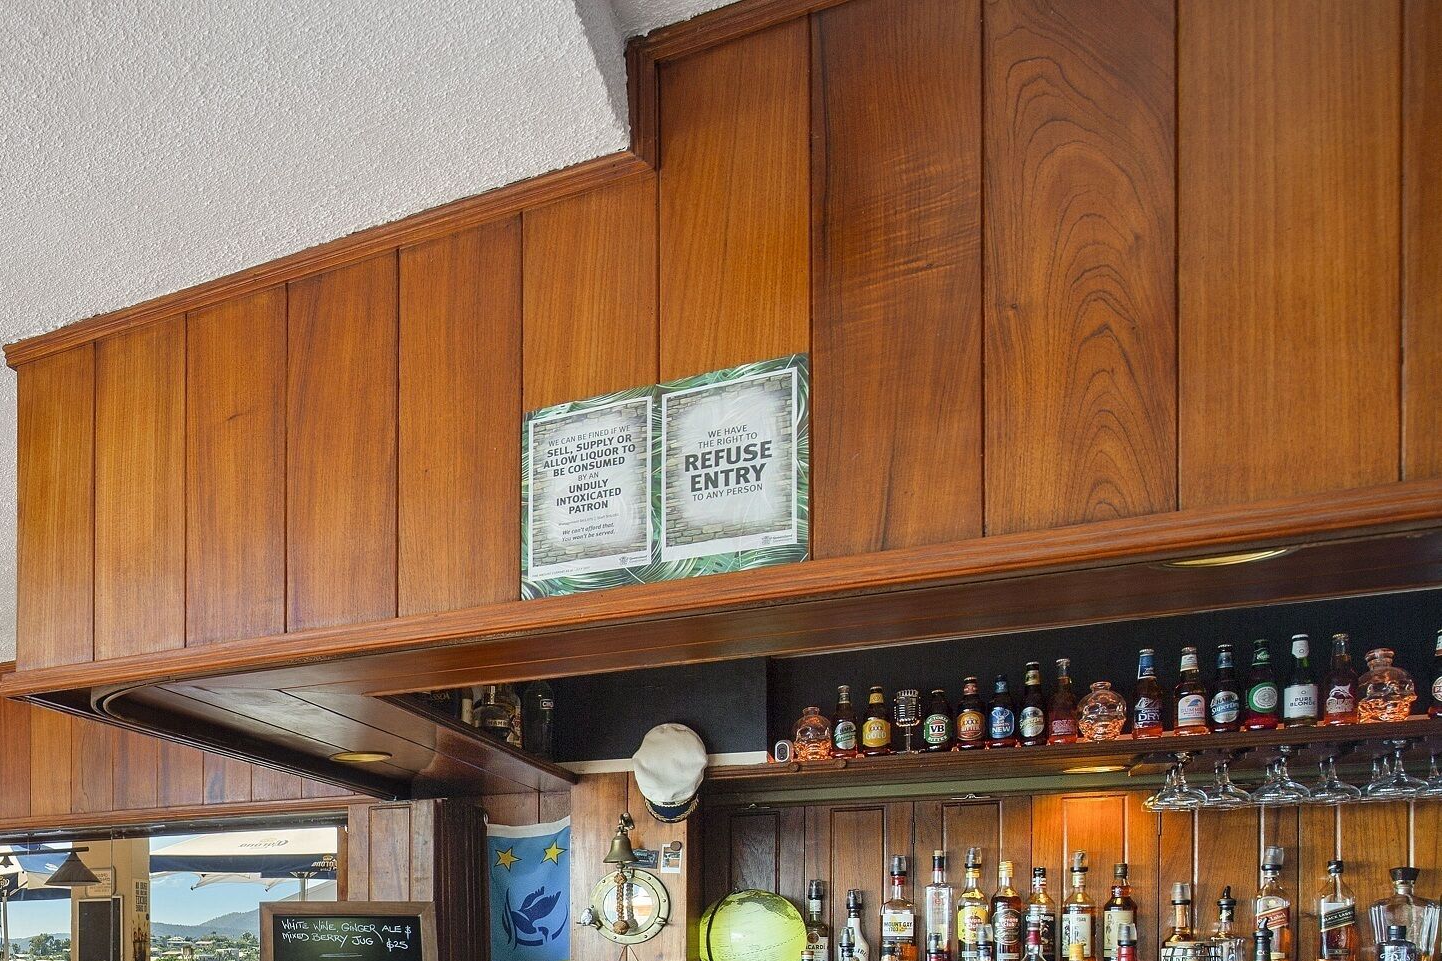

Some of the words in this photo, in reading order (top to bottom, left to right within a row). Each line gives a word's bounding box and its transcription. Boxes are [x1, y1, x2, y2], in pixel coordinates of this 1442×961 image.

[561, 436, 576, 445] CAN
[588, 429, 609, 439] FINED
[619, 425, 631, 433] WE
[708, 429, 722, 438] WE
[724, 425, 748, 435] HAVE
[547, 446, 574, 458] SELL,
[576, 437, 614, 452] SUPPLY
[617, 434, 632, 444] OR
[698, 440, 715, 449] THE
[716, 435, 744, 446] RIGHT
[746, 432, 758, 440] TO
[543, 455, 578, 469] ALLOW
[580, 447, 619, 462] LIQUOR
[622, 444, 636, 454] TO
[684, 440, 773, 473] REFUSE
[553, 468, 566, 477] BE
[567, 456, 625, 474] CONSUMED
[577, 473, 588, 481] BY
[690, 463, 767, 493] ENTRY
[569, 479, 609, 493] UNDULY
[692, 493, 704, 501] TO
[706, 489, 725, 499] ANY
[726, 483, 763, 496] PERSON
[556, 487, 622, 506] INTOXICATED
[568, 500, 608, 514] PATRON
[585, 524, 602, 532] afford
[1138, 713, 1162, 721] DRY
[865, 731, 887, 739] GOLD
[281, 919, 310, 930] WHITE
[381, 925, 402, 933] ALE
[281, 931, 310, 943] MIXED
[311, 932, 349, 948] BERRY
[351, 935, 374, 945] JUG
[386, 938, 409, 952] $25
